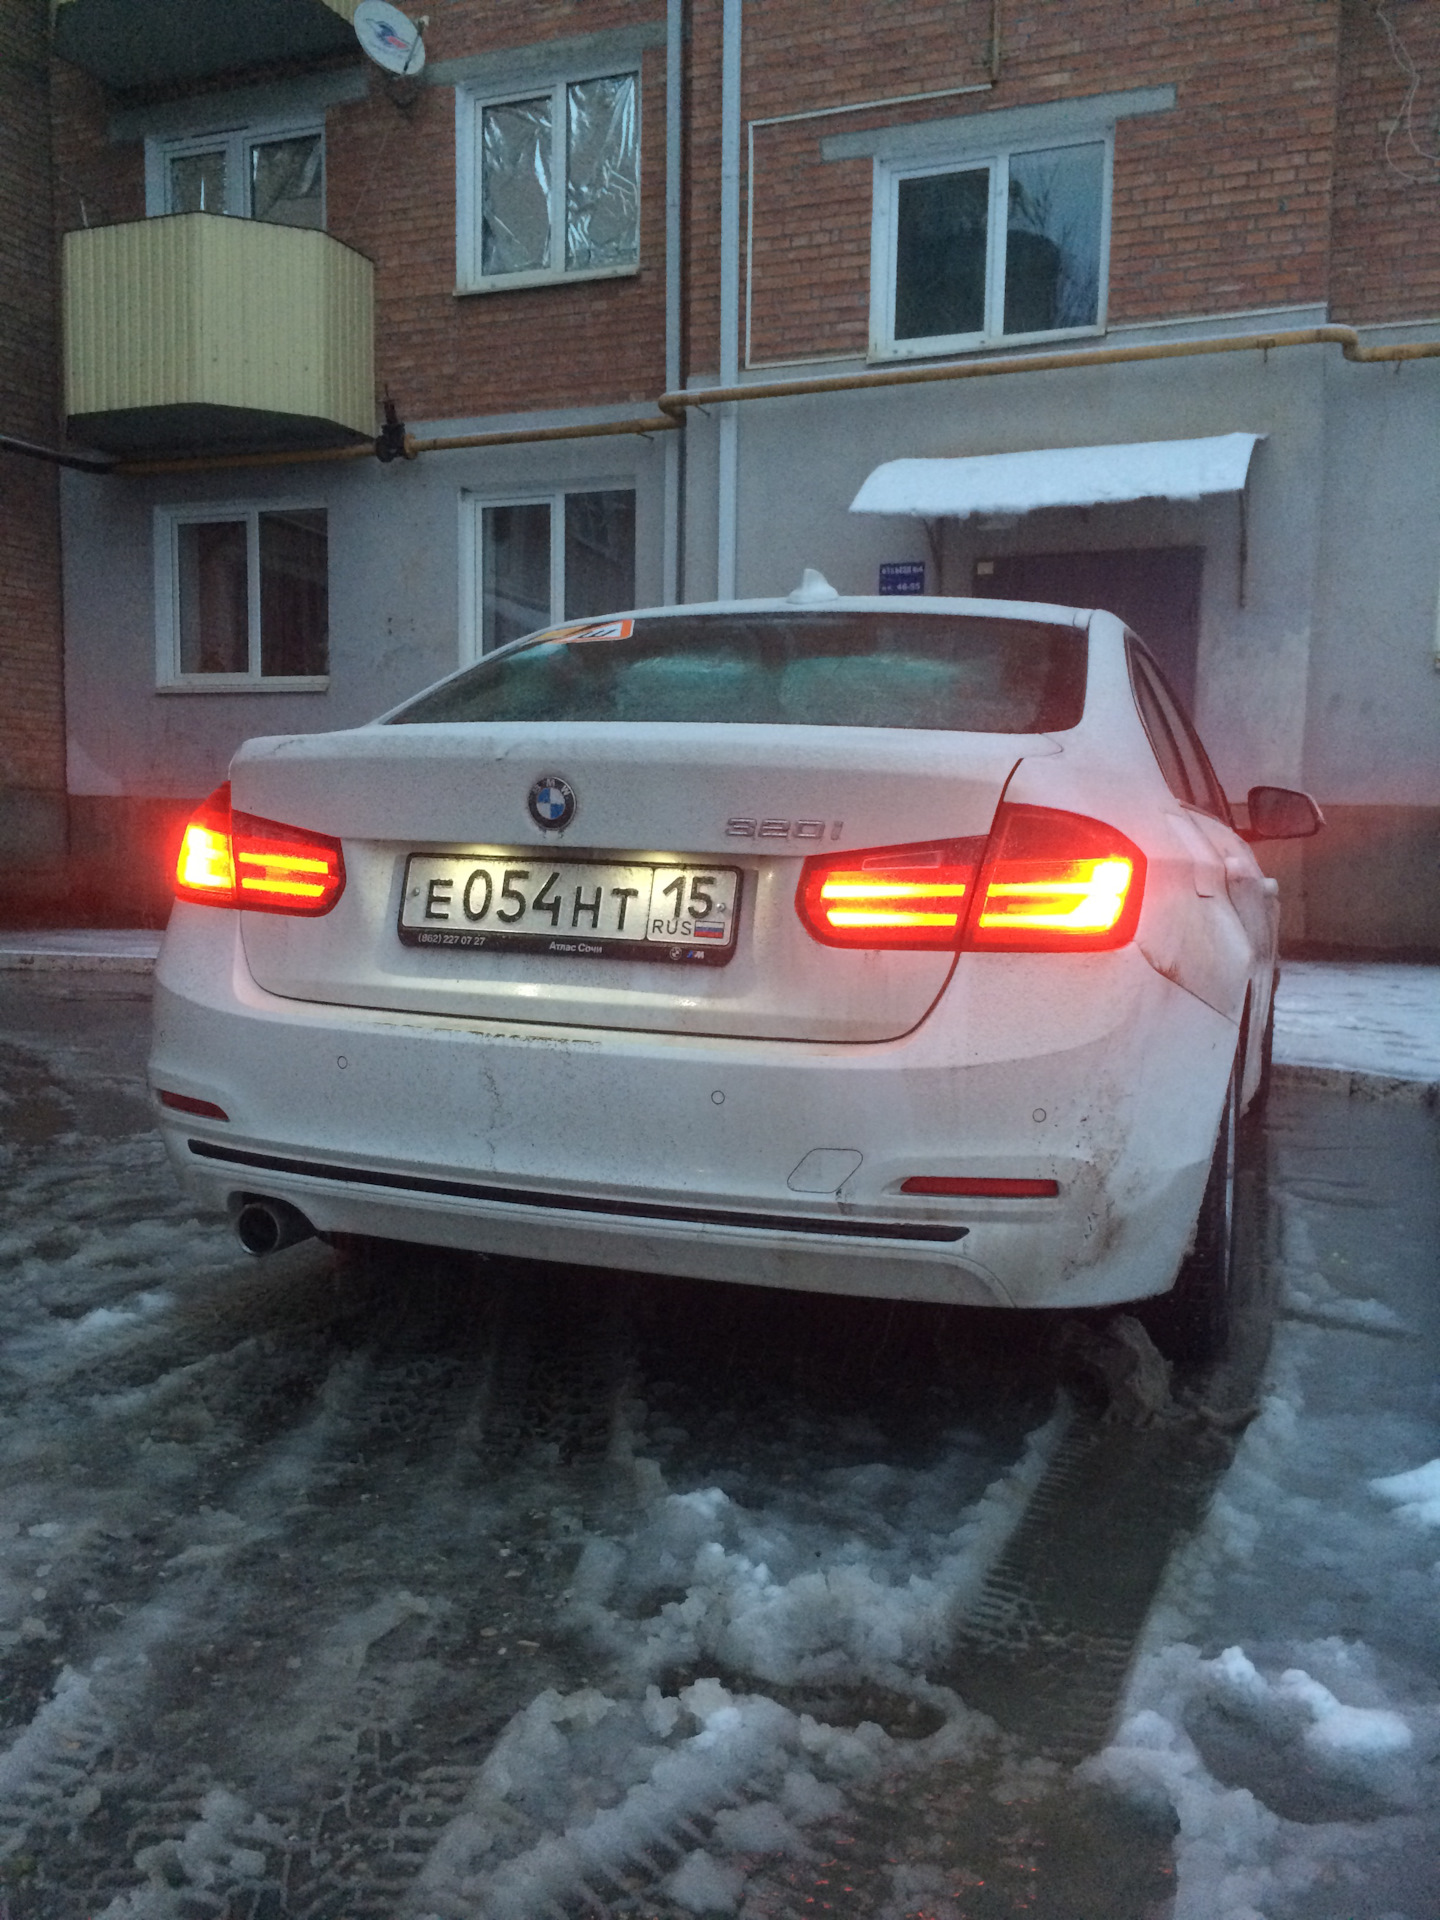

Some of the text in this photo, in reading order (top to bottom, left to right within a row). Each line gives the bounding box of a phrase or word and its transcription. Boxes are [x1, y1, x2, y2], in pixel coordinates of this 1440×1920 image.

[725, 817, 844, 841] 320i
[662, 875, 717, 919] 15
[652, 919, 692, 936] RUS
[418, 933, 486, 946] (862) 227 07 27
[549, 941, 603, 954] Атлас Сочи
